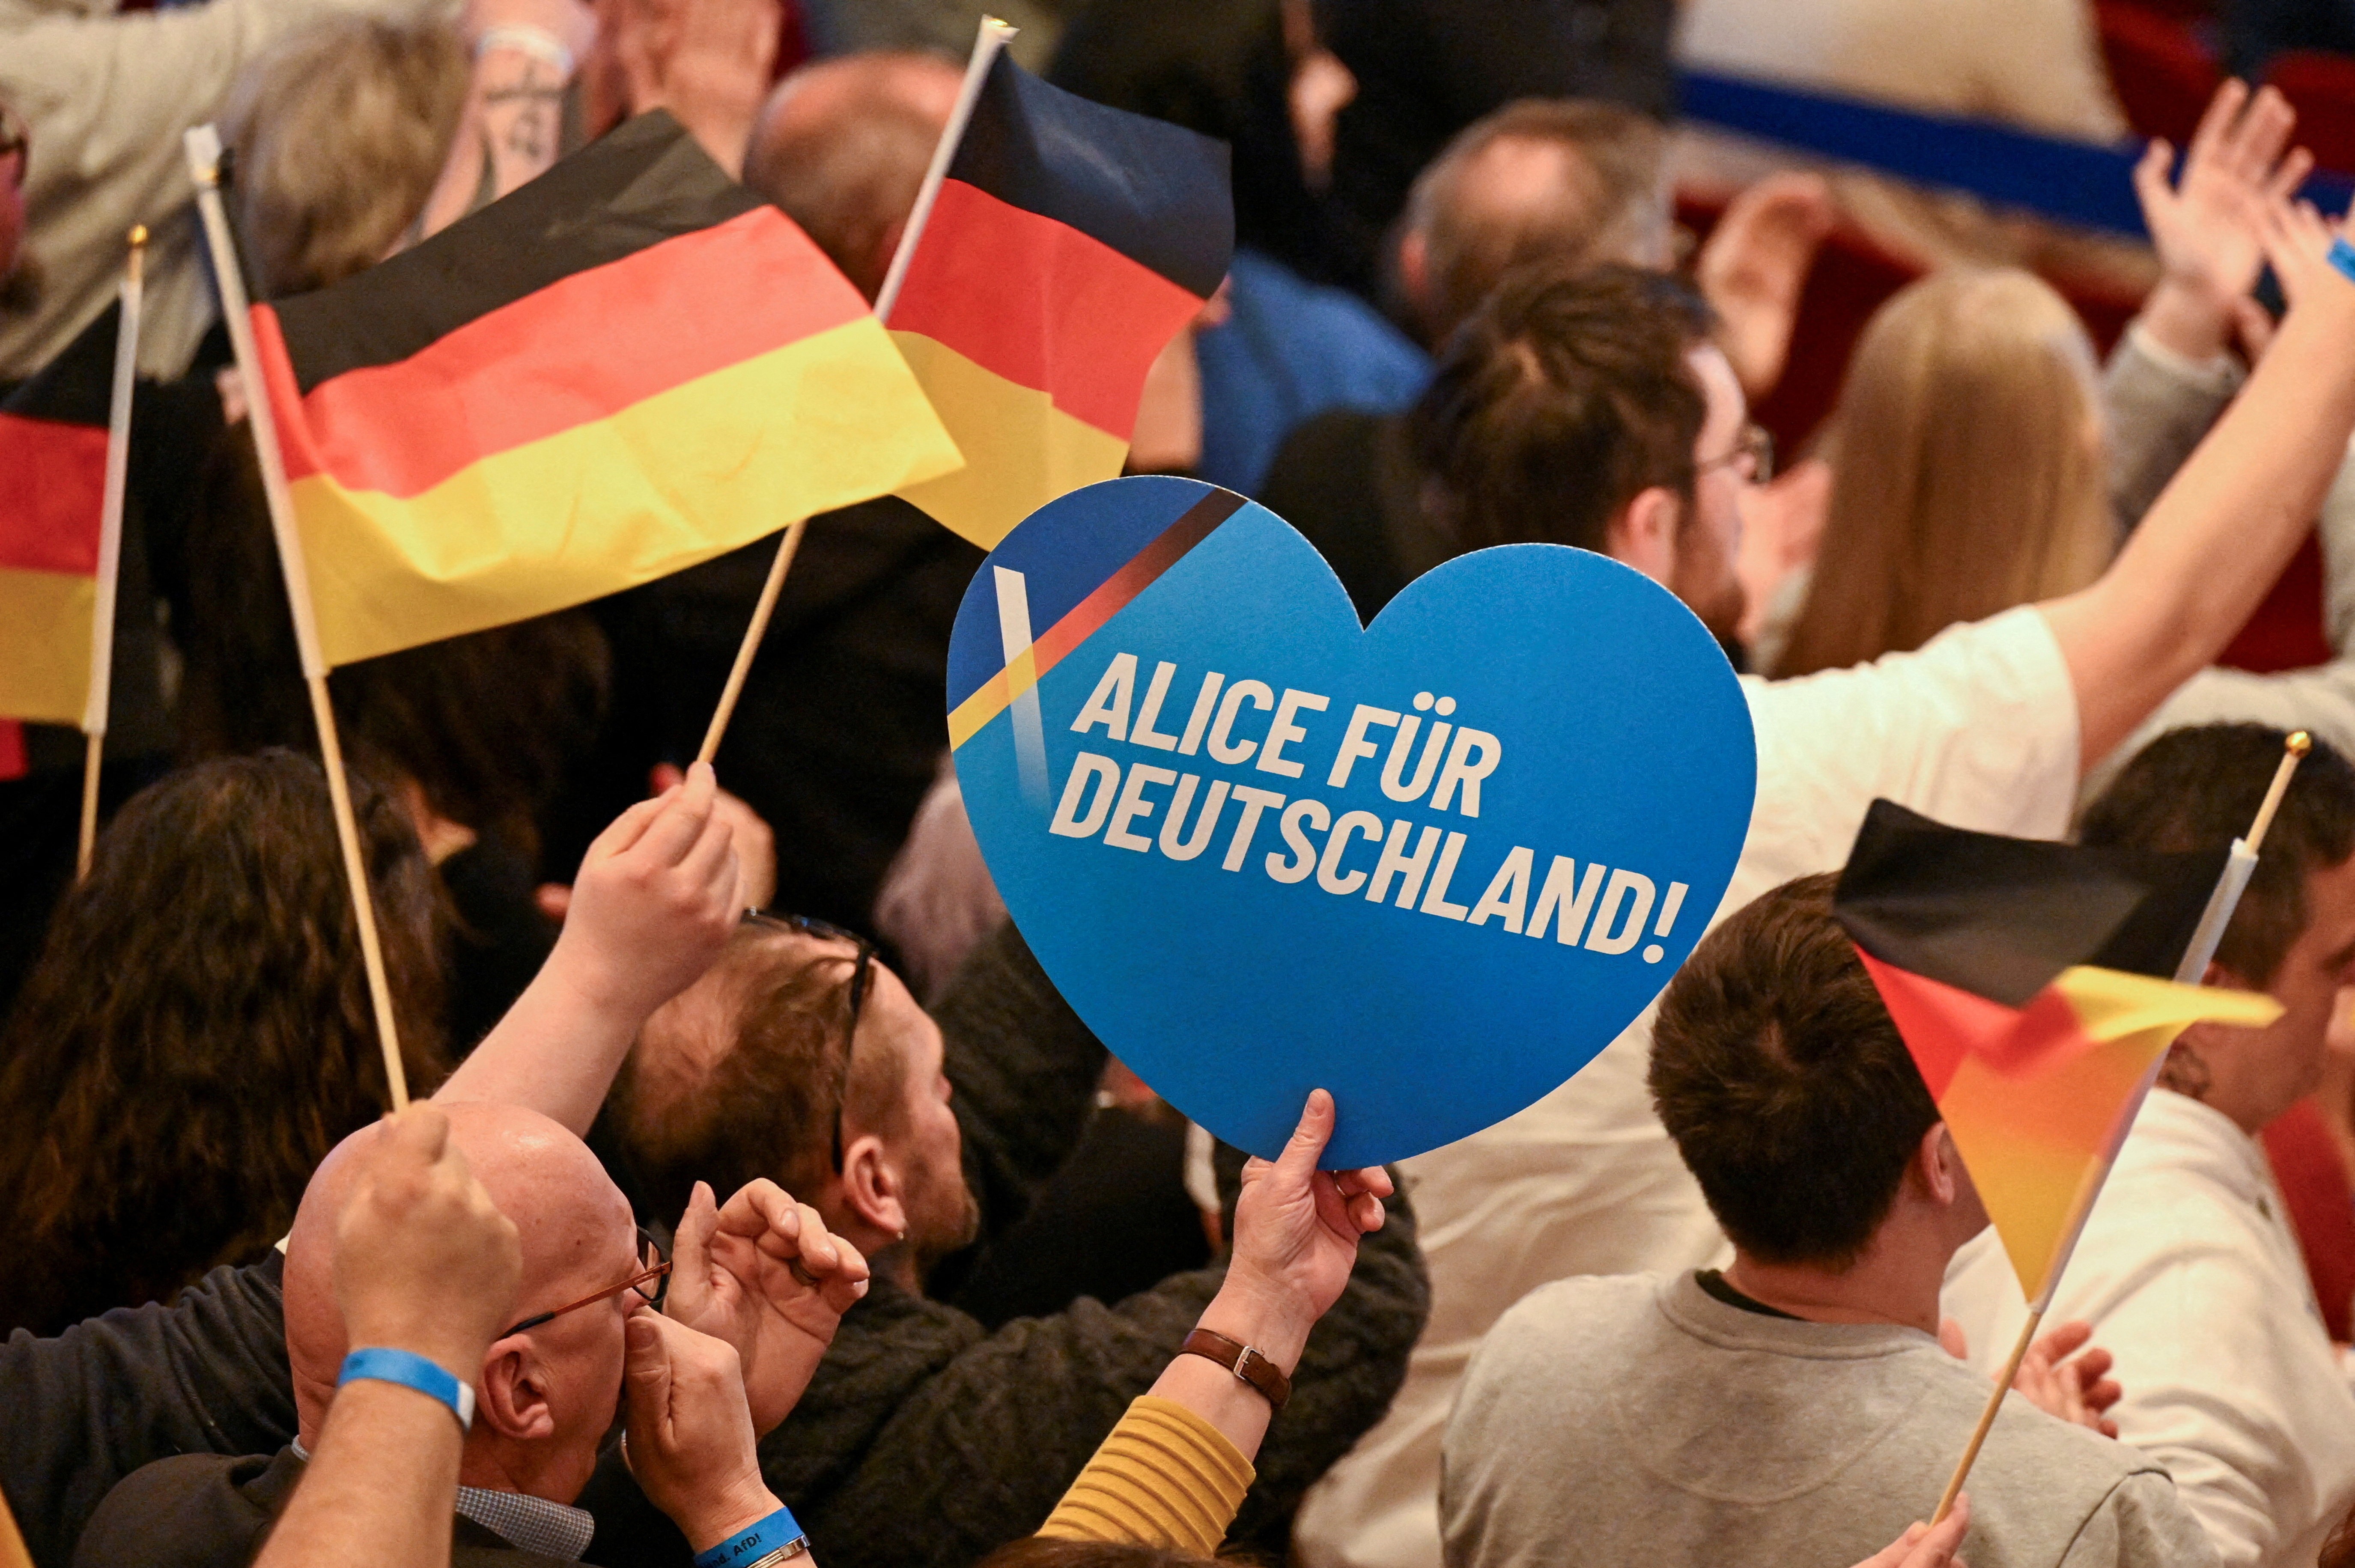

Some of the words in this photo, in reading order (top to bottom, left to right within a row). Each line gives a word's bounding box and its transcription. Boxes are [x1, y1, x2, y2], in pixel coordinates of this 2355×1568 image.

[1070, 652, 1330, 779] ALICE
[1327, 691, 1502, 818] FÜR
[1049, 751, 1689, 964] DEUTSCHLAND!
[733, 1533, 763, 1557] AfD!
